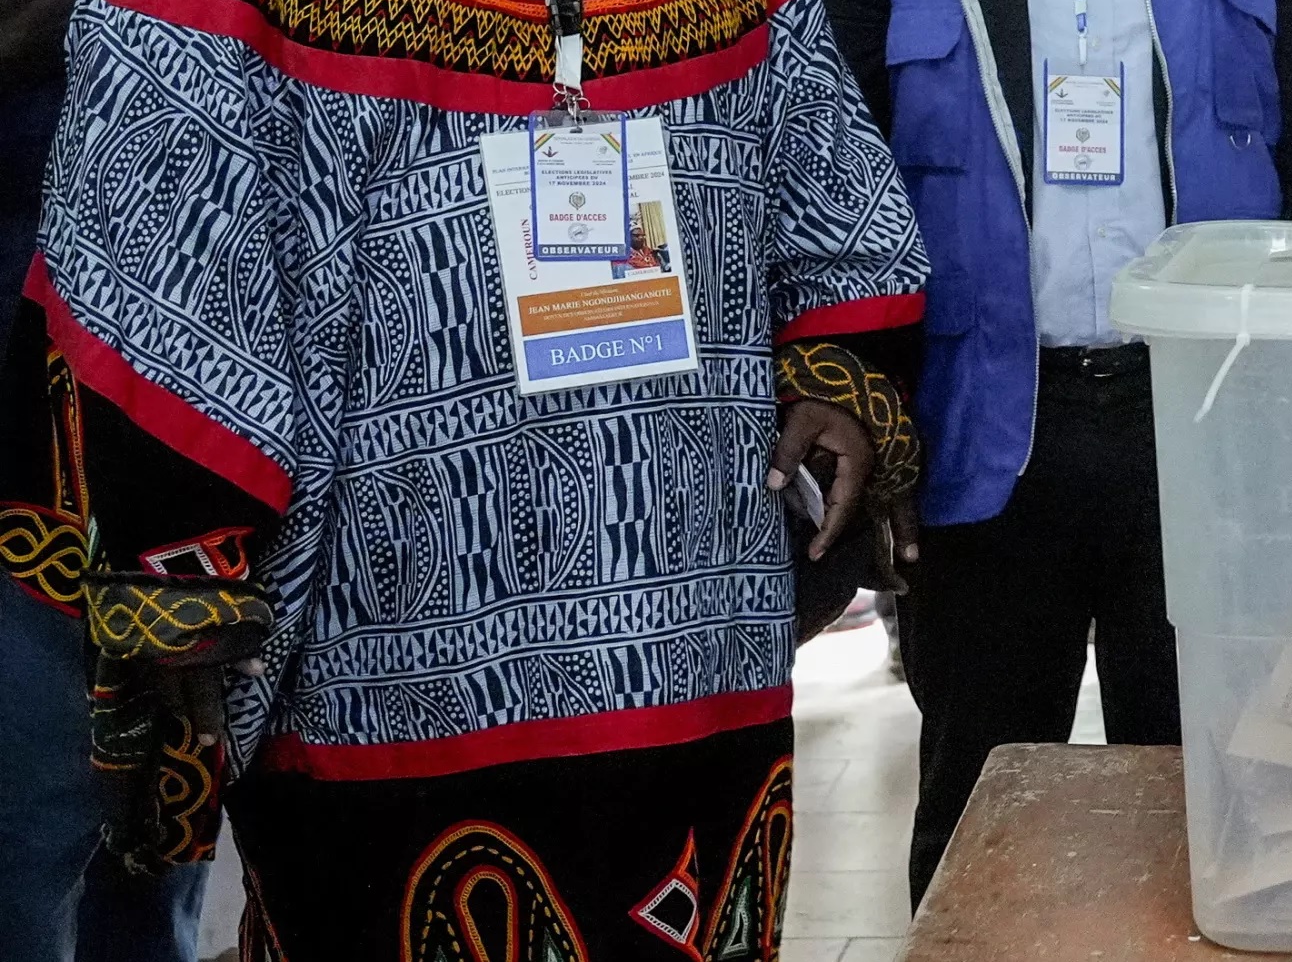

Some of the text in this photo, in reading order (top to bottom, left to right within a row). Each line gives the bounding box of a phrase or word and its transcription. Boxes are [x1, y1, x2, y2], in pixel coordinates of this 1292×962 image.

[1052, 172, 1116, 181] OBSERVATEUR
[549, 213, 607, 221] BADGE D'ACCES
[541, 246, 619, 254] OBSERVATEUR
[529, 305, 551, 315] JEAN
[552, 299, 582, 311] MARIE
[550, 334, 663, 366] BADGE N°1
